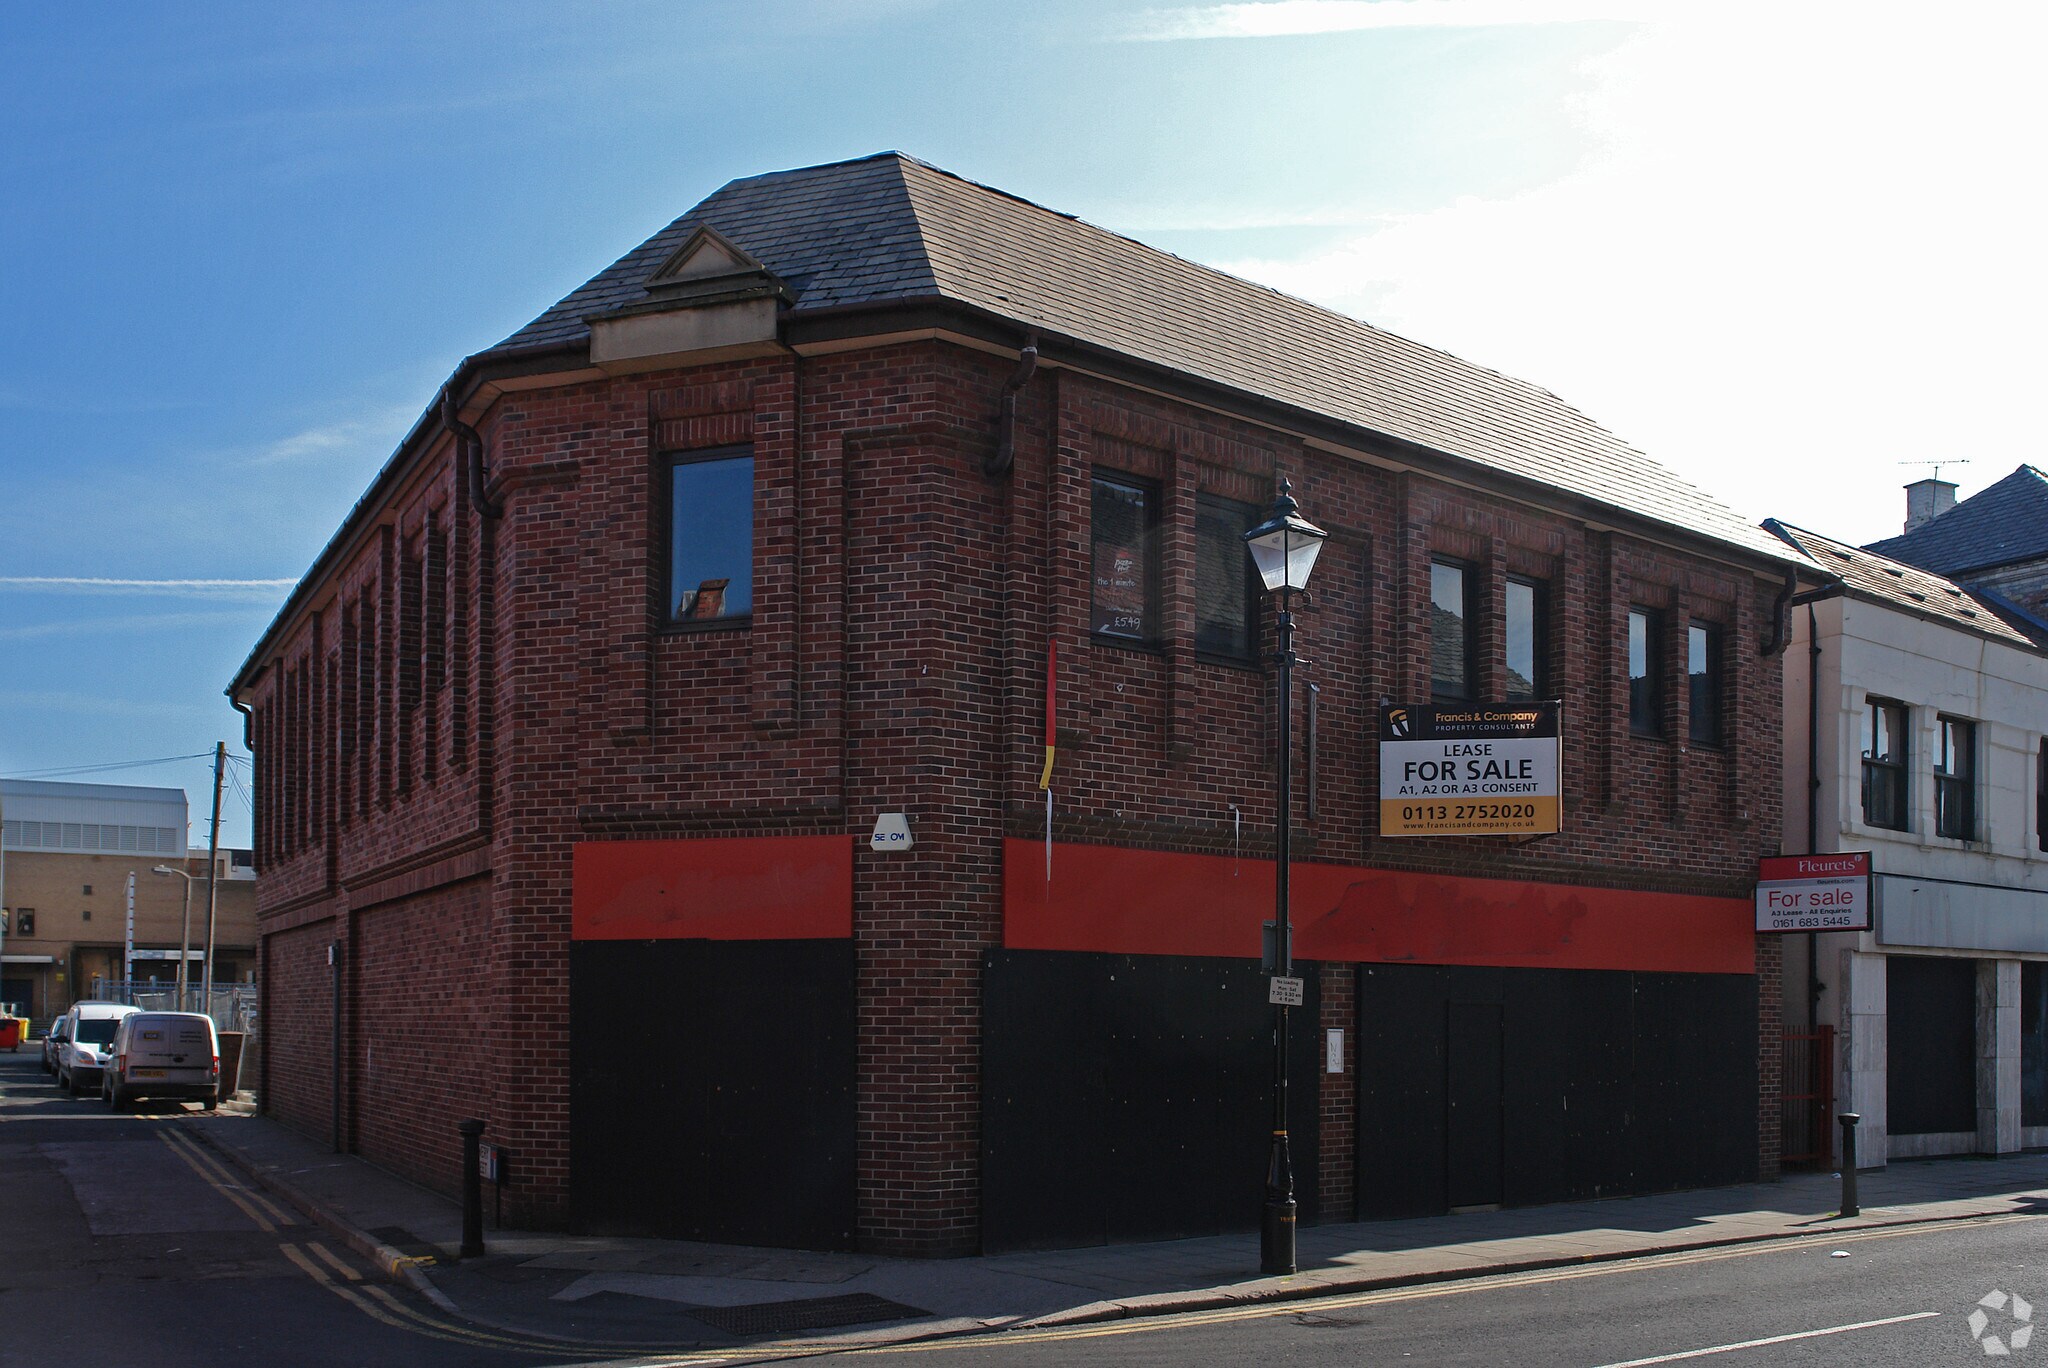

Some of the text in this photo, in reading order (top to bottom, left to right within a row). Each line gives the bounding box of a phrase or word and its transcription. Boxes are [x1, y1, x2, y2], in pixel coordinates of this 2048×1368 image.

[1097, 577, 1109, 586] the
[1435, 711, 1538, 723] Francis & Company
[1479, 723, 1536, 731] CONSULTANTS
[1444, 744, 1492, 757] LEASE
[1404, 759, 1533, 781] FOR SALE
[1399, 782, 1539, 796] A1, A2 OR A3 CONSENT
[1402, 804, 1535, 820] 0113 2752020
[1403, 820, 1535, 829] www.francisandcompany.co.uk
[1798, 860, 1856, 872] Fleurets
[1768, 888, 1853, 907] For sale
[1772, 919, 1794, 928] 0161
[1798, 918, 1819, 927] 683
[1823, 916, 1850, 926] 5445
